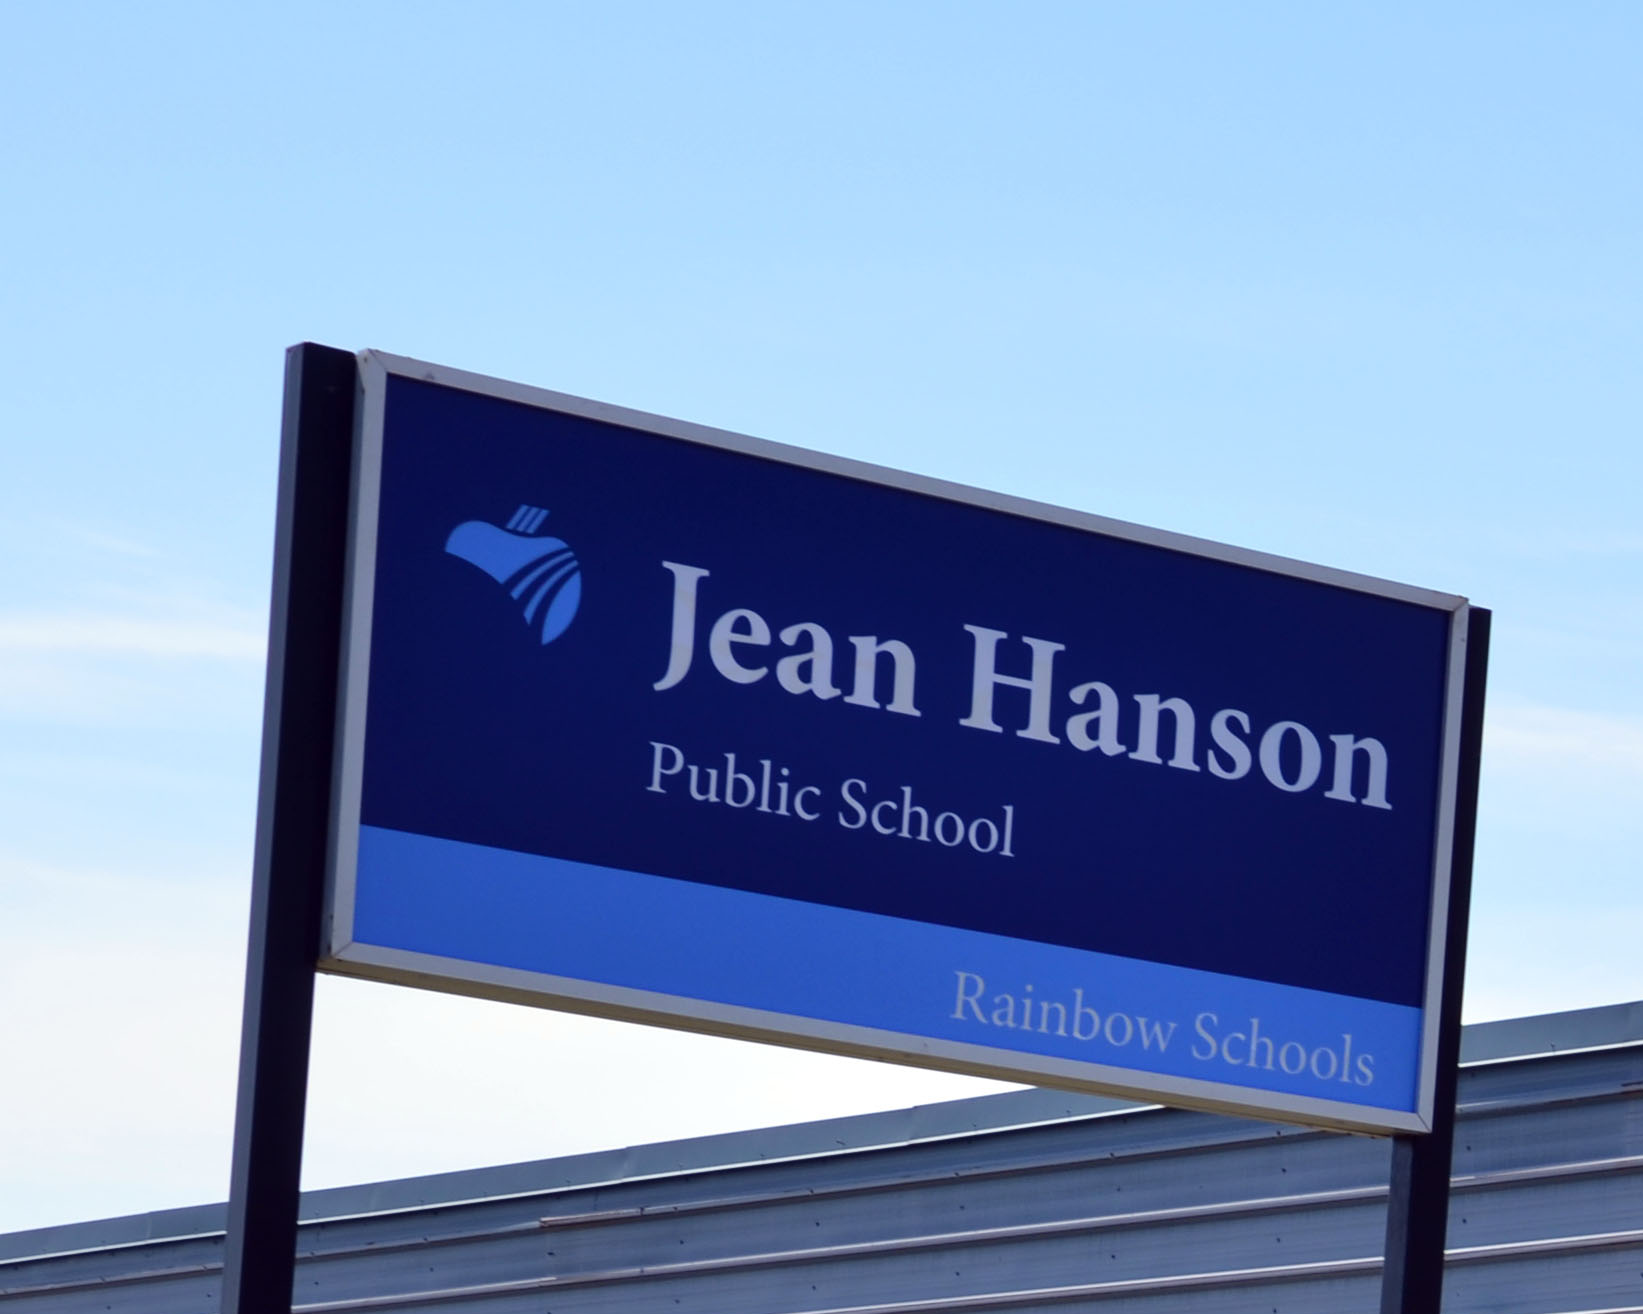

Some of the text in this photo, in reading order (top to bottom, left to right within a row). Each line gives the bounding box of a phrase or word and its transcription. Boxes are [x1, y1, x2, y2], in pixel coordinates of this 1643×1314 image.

[653, 560, 1393, 811] Jean Hanson
[646, 741, 1016, 857] Public School
[949, 970, 1375, 1087] Rainbow Schools
